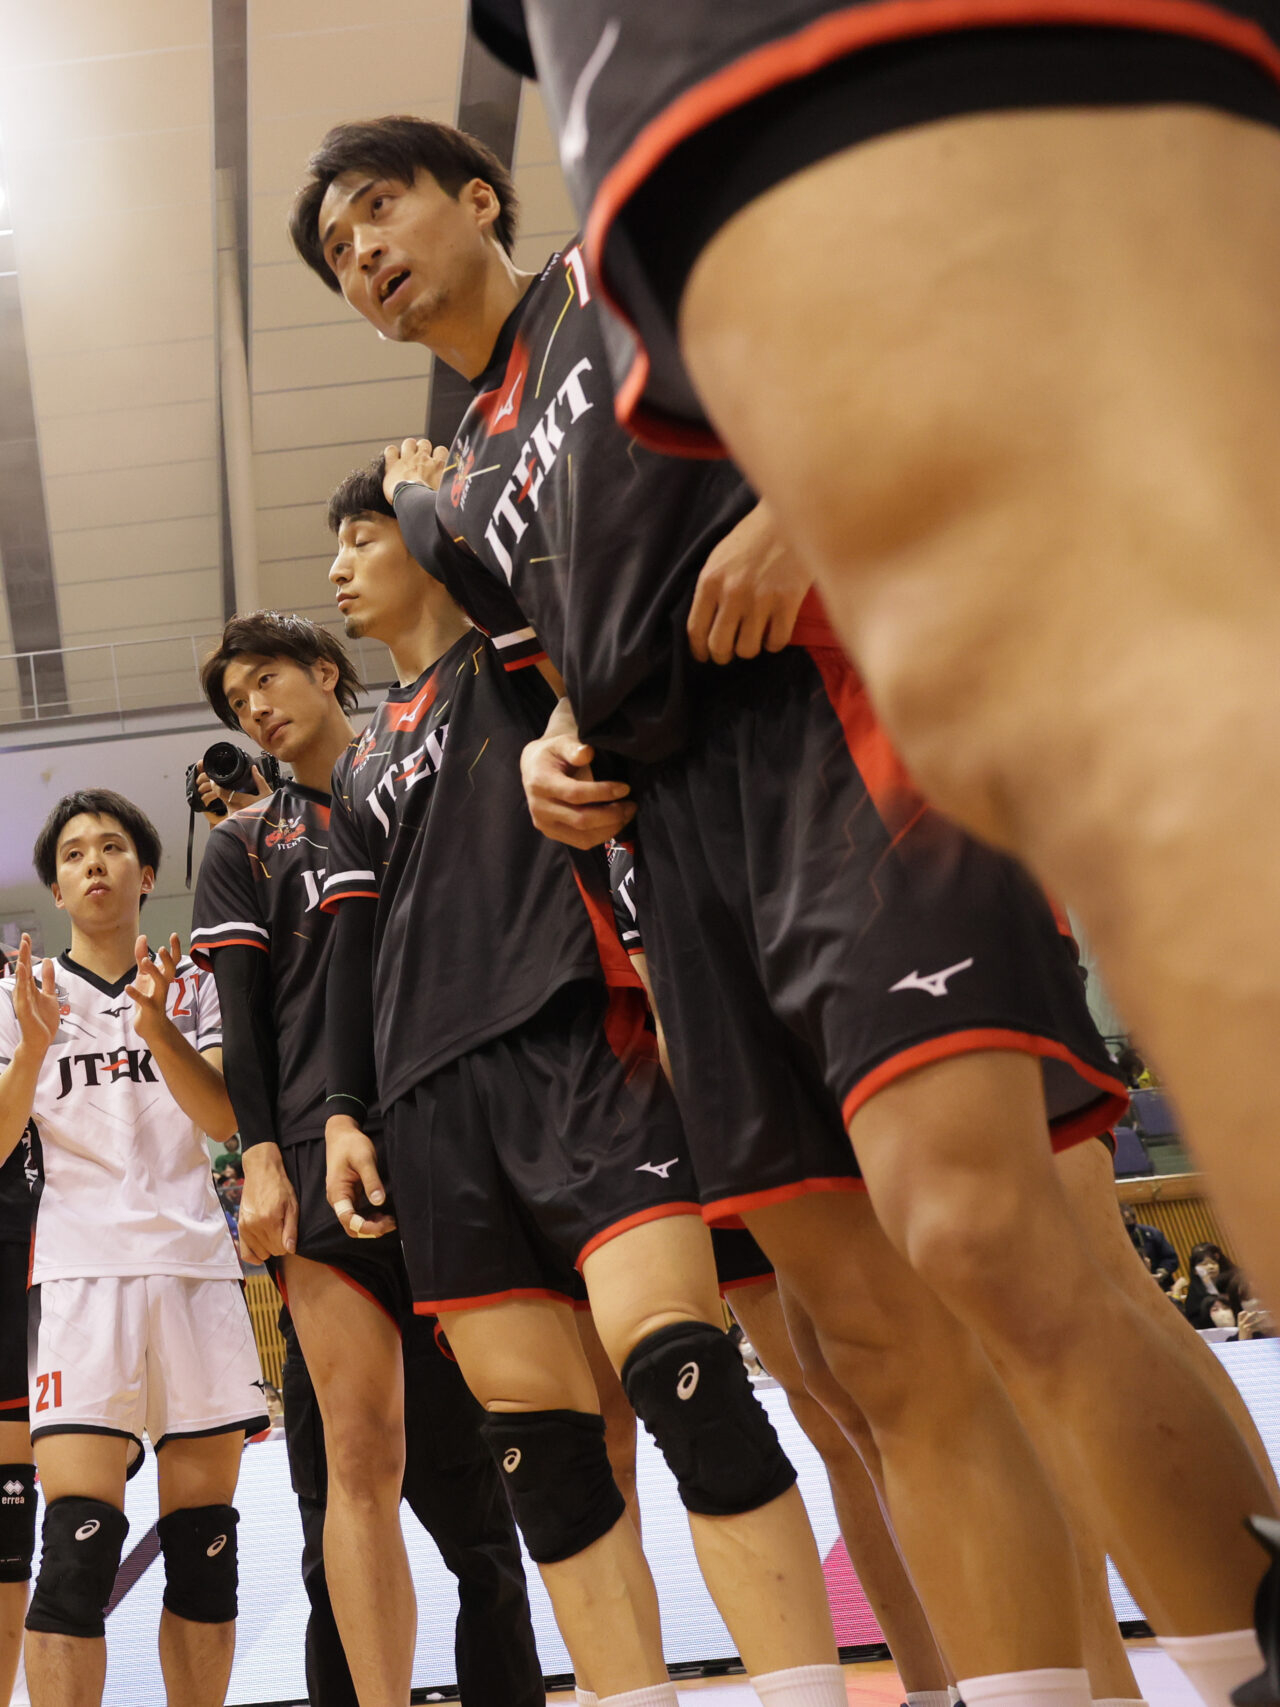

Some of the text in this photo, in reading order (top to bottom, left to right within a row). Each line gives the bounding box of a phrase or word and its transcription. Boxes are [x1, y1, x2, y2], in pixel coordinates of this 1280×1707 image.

[484, 357, 594, 587] JTEKT
[366, 724, 449, 839] JTEK
[56, 1046, 160, 1100] JTEK
[35, 1370, 62, 1413] 21
